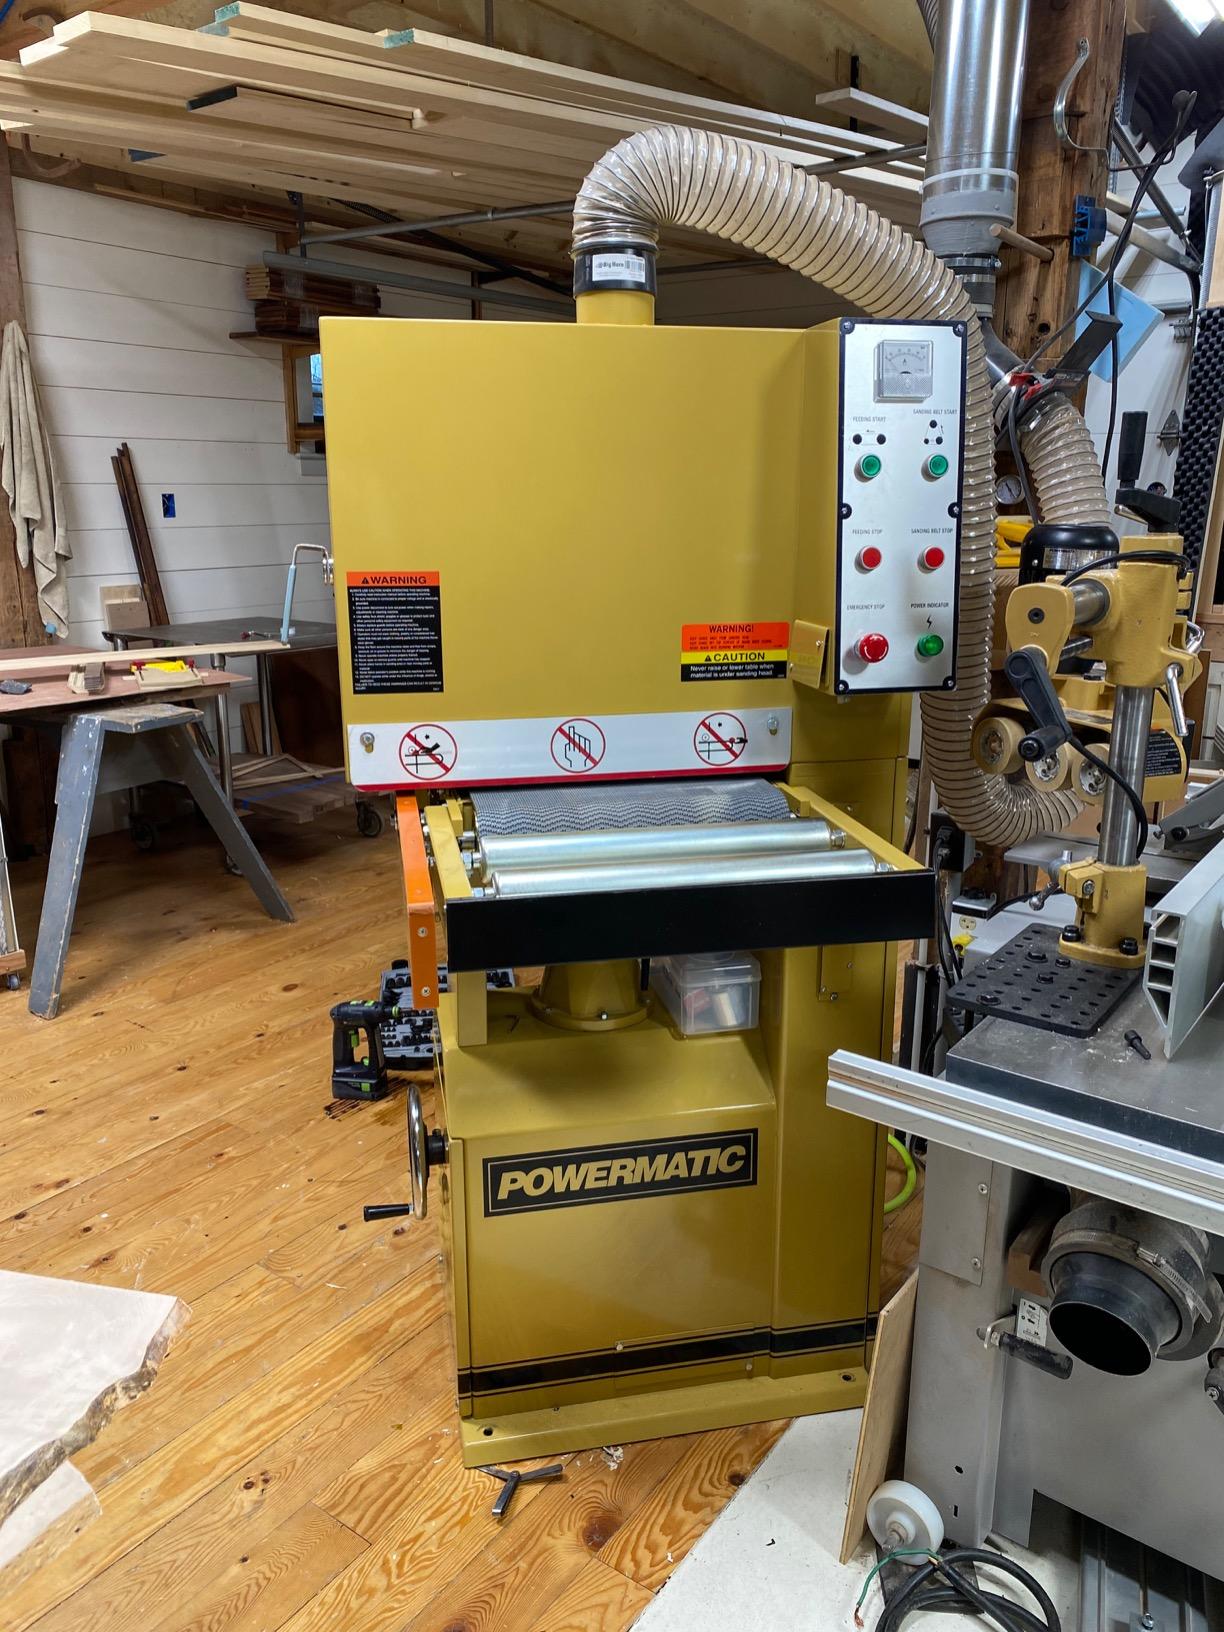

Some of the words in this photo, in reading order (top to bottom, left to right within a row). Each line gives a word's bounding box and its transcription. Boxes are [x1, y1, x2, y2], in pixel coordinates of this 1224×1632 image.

[370, 576, 427, 584] WARNING
[709, 624, 754, 633] WARNING!
[713, 652, 765, 662] CAUTION
[497, 1144, 746, 1200] POWERMATIC
